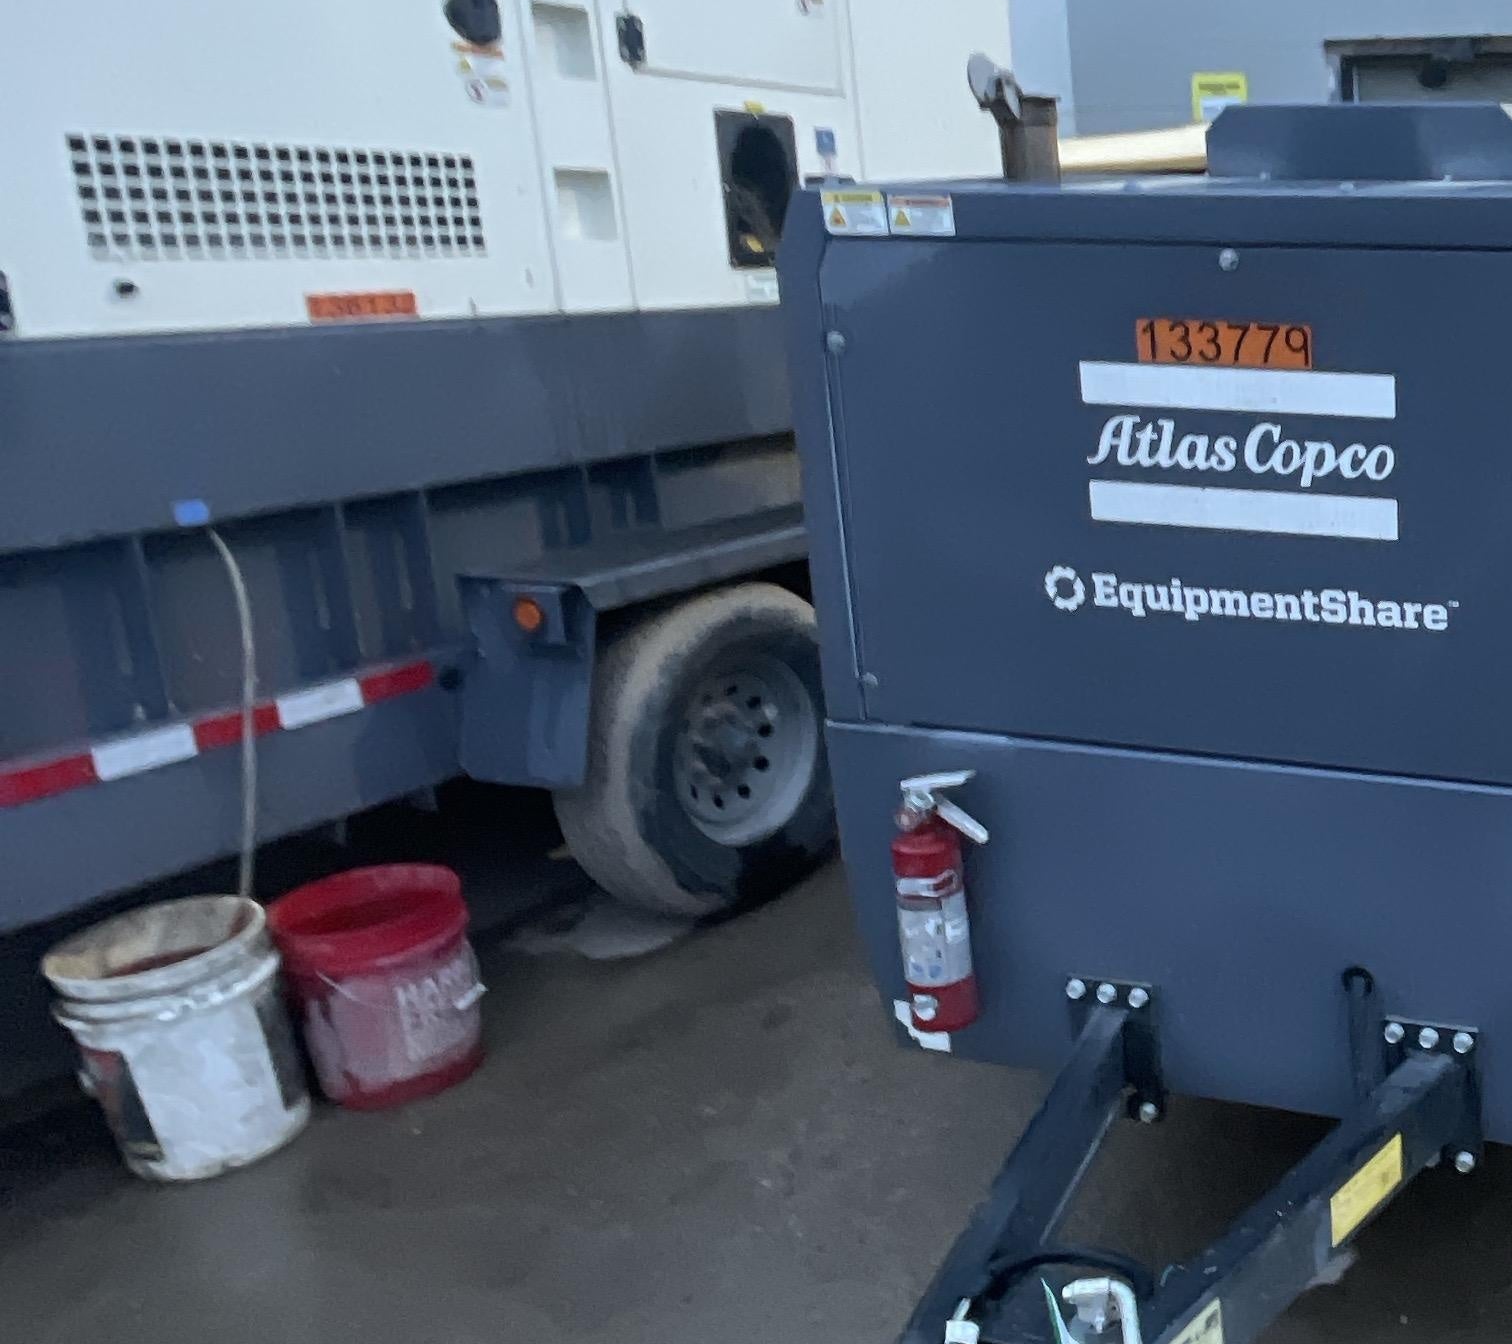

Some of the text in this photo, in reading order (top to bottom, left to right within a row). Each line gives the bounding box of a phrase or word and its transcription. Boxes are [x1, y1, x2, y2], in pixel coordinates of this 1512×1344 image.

[1141, 319, 1311, 368] 133779
[1086, 415, 1396, 488] Atlas Copco
[1091, 572, 1449, 632] EquipmentShare
